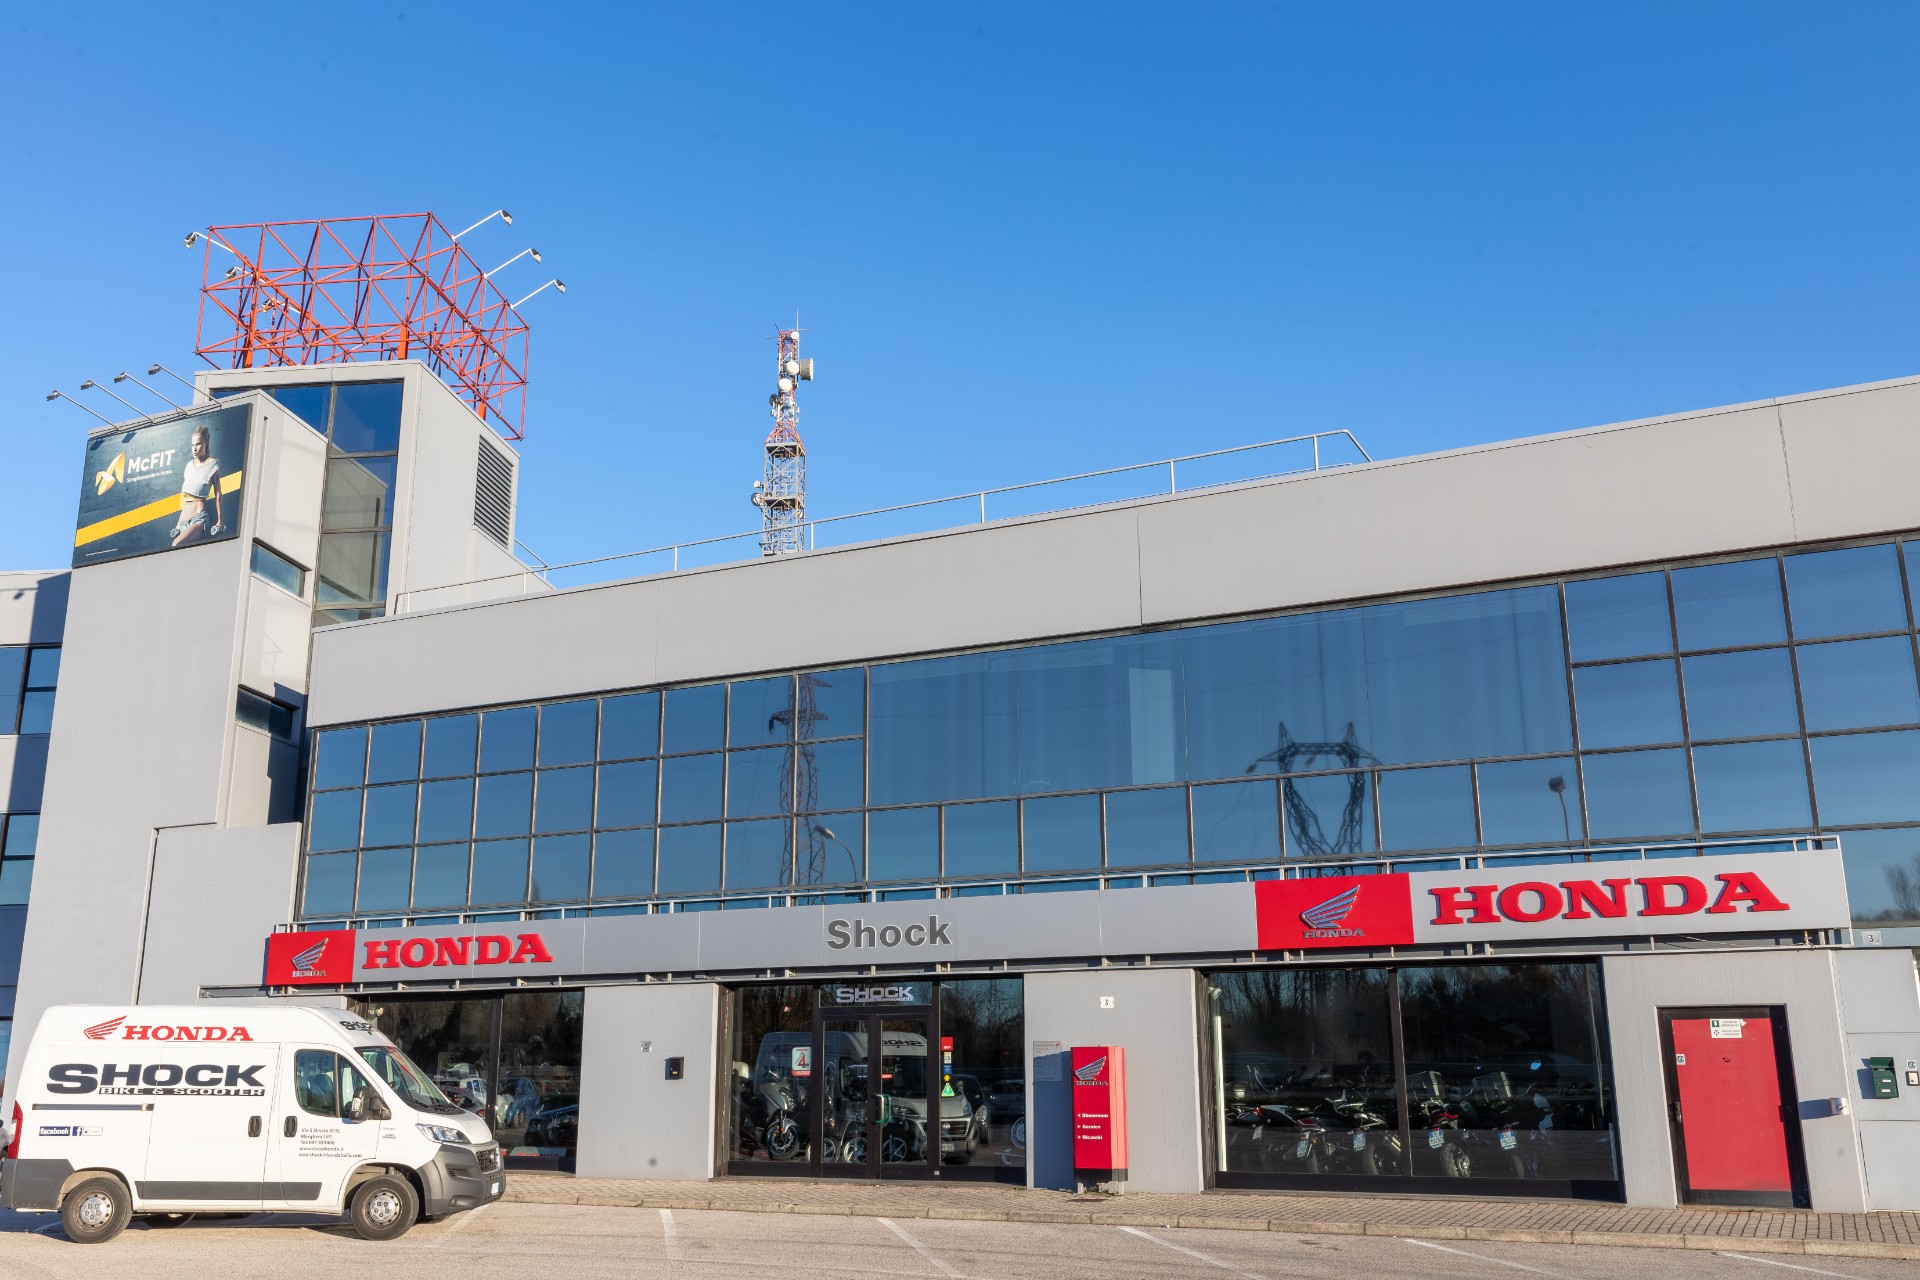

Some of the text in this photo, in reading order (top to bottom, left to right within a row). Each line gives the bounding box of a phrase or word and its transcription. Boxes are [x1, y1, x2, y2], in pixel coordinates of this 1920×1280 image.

[127, 449, 175, 474] McFIT
[1428, 872, 1790, 925] HONDA
[826, 915, 952, 949] Shock
[1303, 928, 1366, 938] HONDA
[362, 933, 554, 969] HONDA
[836, 986, 914, 1002] SHOCK
[122, 1025, 253, 1041] HONDA
[46, 1063, 267, 1094] SHOCK
[100, 1087, 264, 1096] BIKE & SCOOTER
[40, 1127, 69, 1135] facebook
